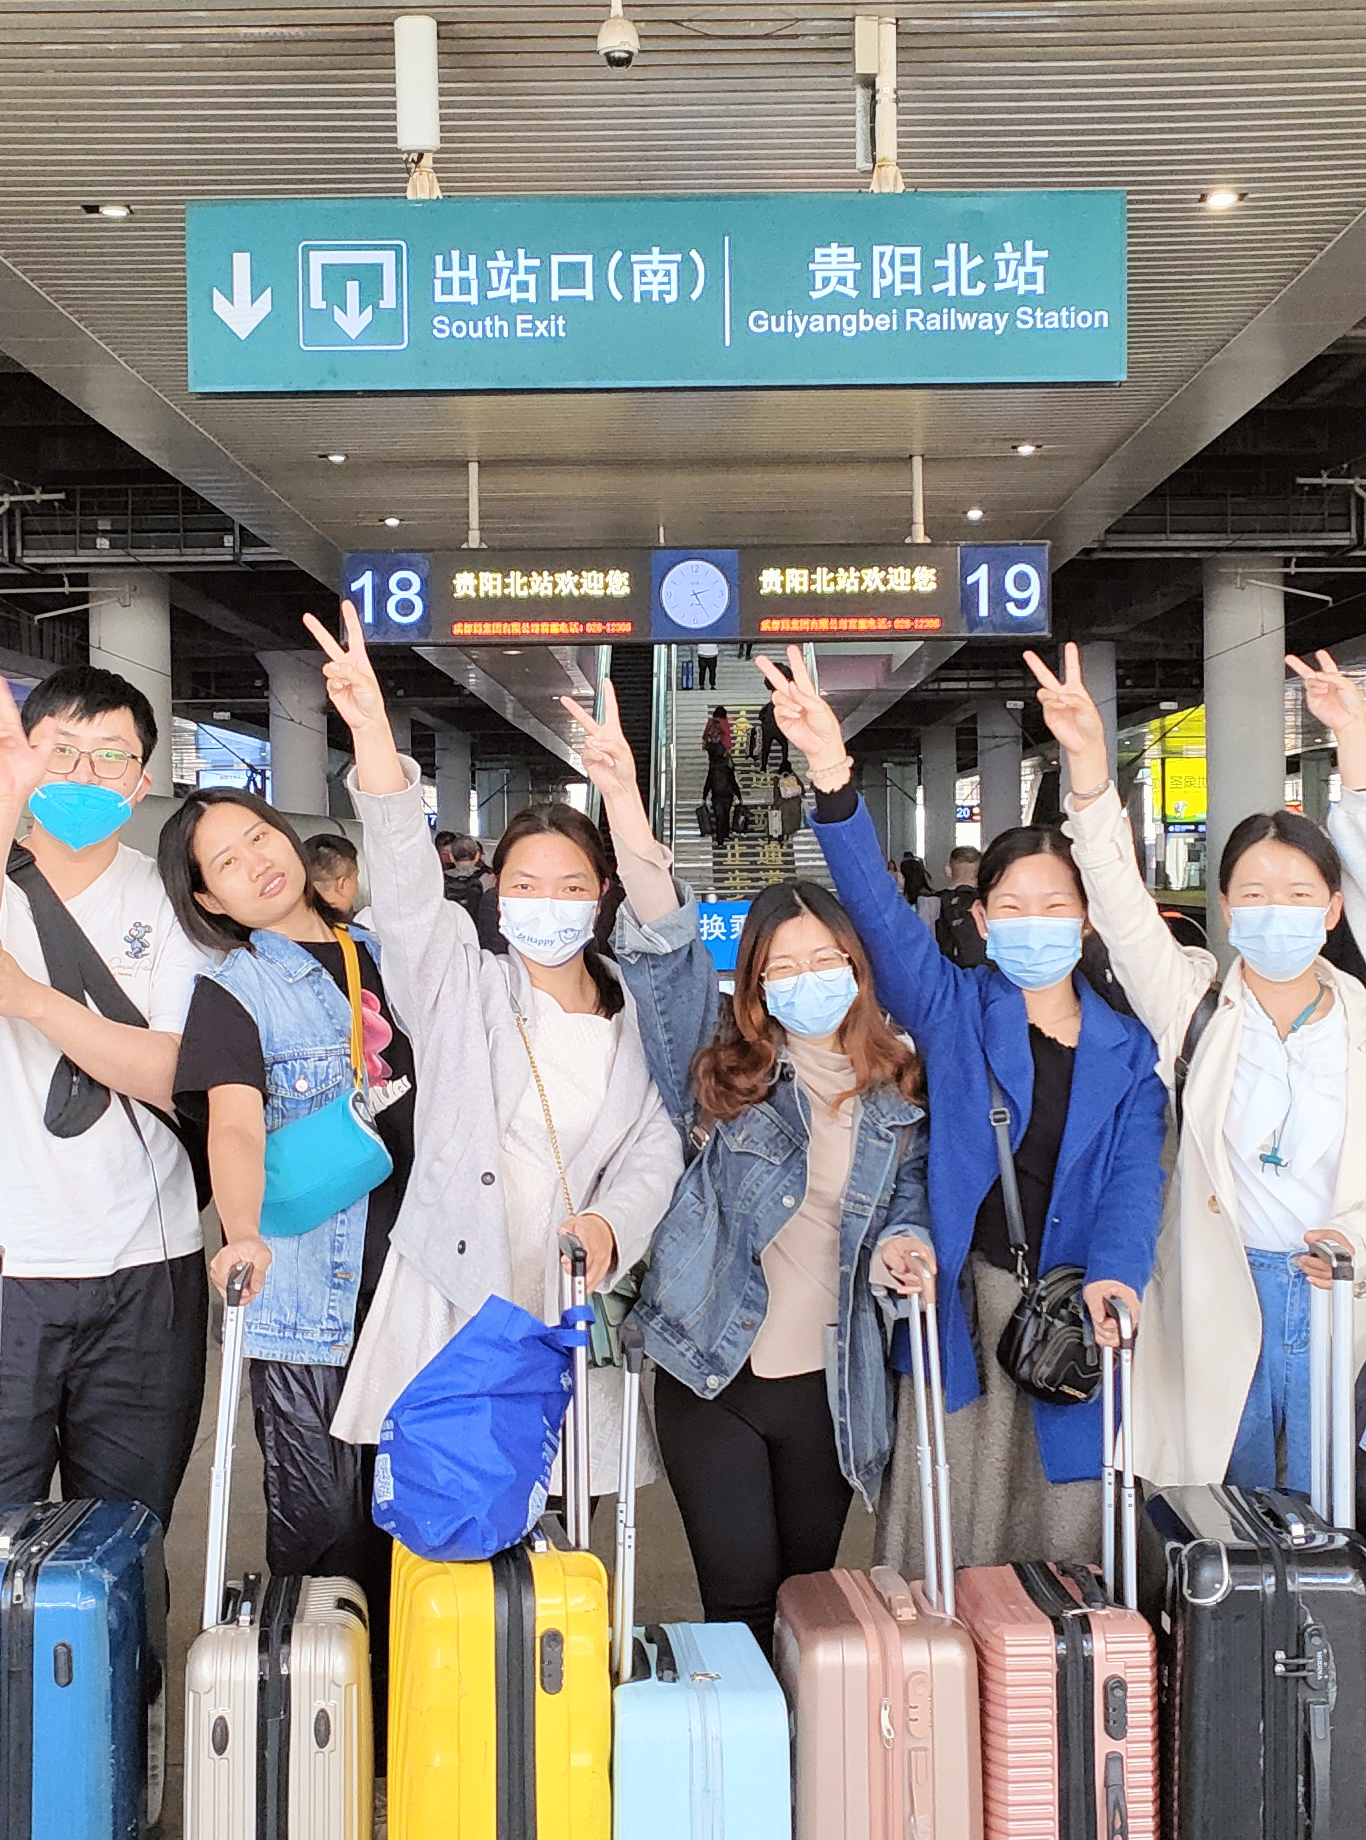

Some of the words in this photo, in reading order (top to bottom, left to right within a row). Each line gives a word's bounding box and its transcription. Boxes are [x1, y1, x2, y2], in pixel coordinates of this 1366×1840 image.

[808, 240, 1049, 299] 贵阳北站
[432, 315, 508, 339] South
[516, 314, 567, 338] Exit
[748, 309, 897, 337] Guiyangbei
[905, 308, 1009, 335] Railway
[1015, 307, 1109, 329] Station
[452, 569, 631, 598] 贵阳北站欢迎您
[690, 564, 700, 574] 12
[758, 565, 938, 594] 贵阳北站欢迎您
[349, 570, 424, 625] 18
[966, 563, 1040, 618] 19
[956, 806, 971, 819] 20
[526, 936, 555, 947] Happy
